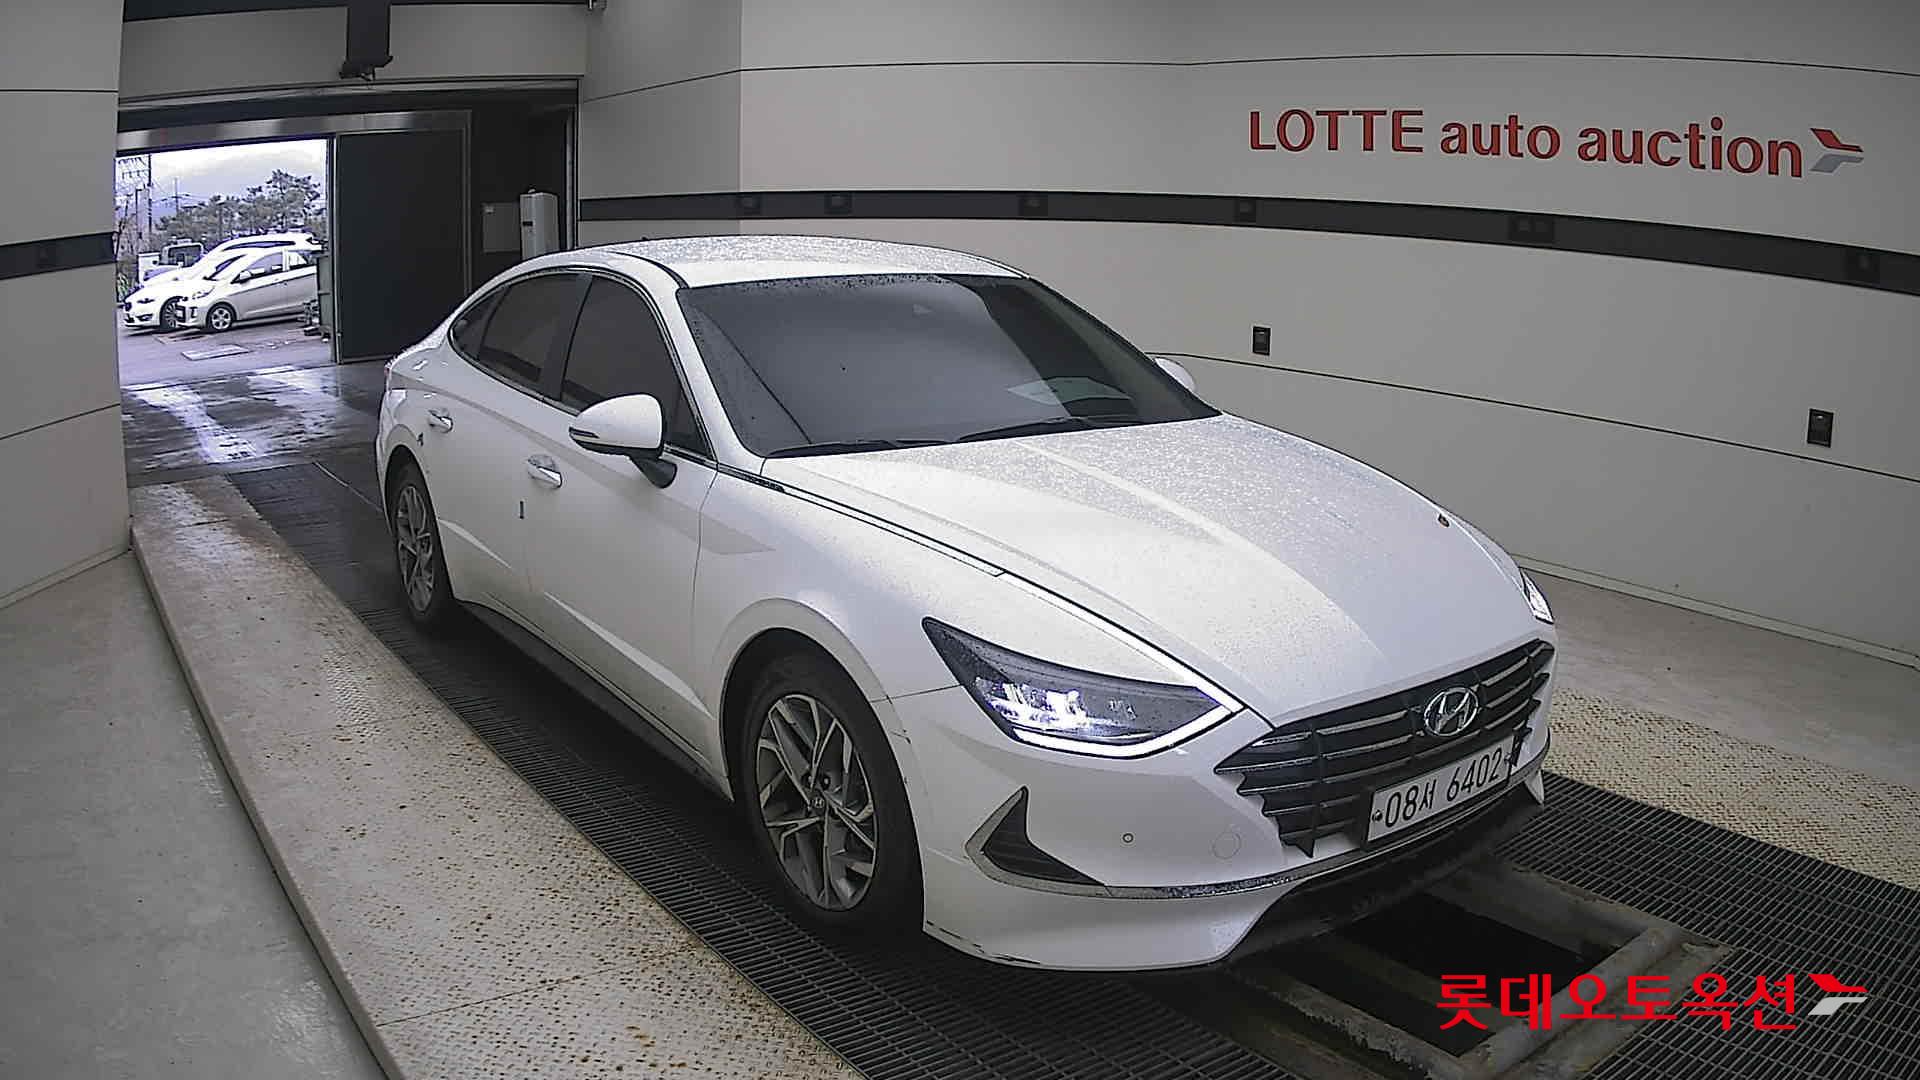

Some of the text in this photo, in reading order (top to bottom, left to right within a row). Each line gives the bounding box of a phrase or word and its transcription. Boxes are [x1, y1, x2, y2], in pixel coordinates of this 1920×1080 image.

[1249, 110, 1802, 177] LOTTE auto auction
[1385, 748, 1502, 828] 08서 6402
